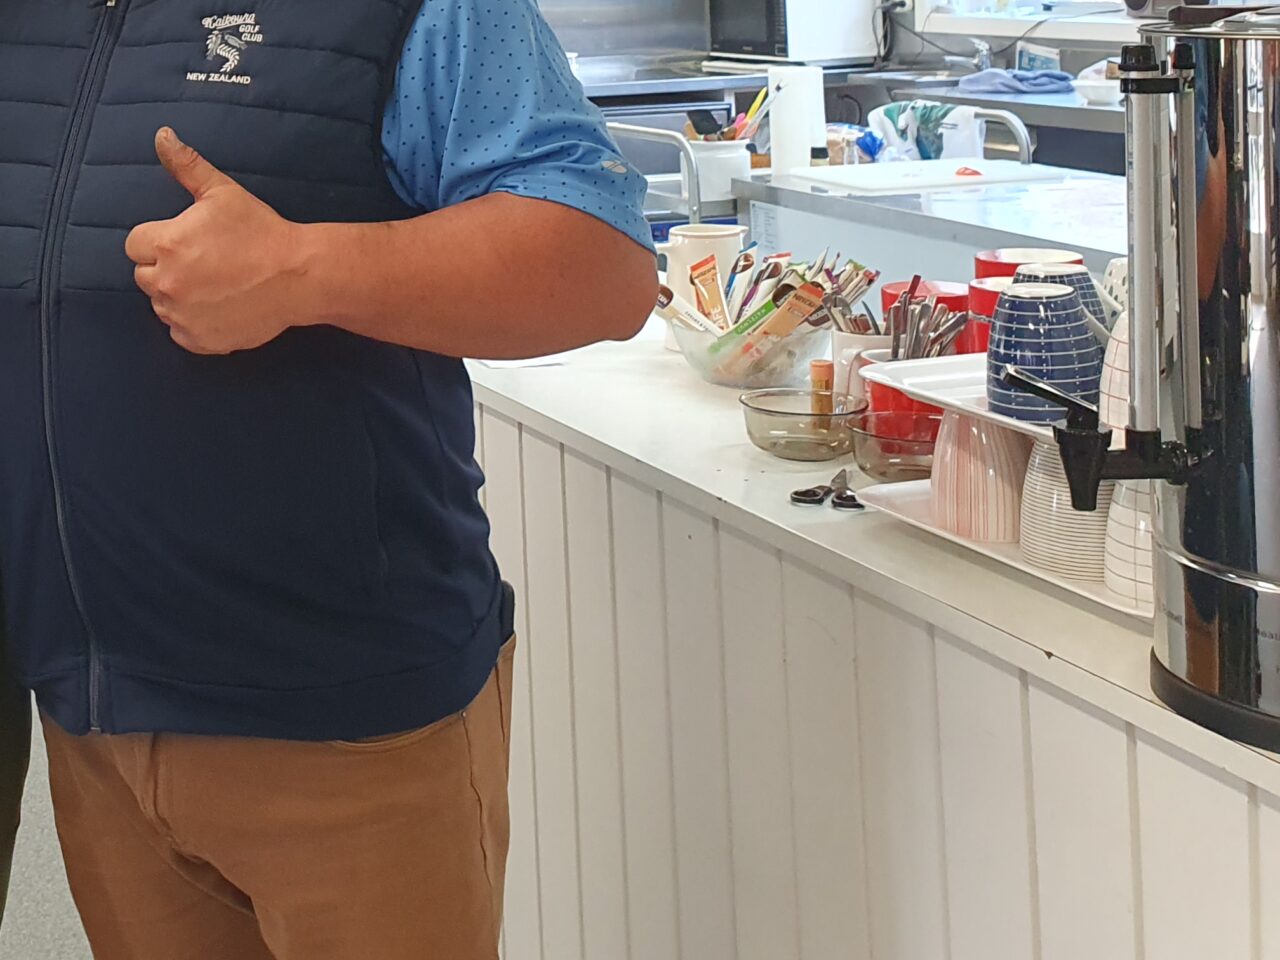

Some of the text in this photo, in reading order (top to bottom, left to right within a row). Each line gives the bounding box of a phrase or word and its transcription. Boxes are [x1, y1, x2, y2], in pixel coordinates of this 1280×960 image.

[201, 13, 256, 30] Kaikoura
[239, 25, 260, 33] GOLF
[241, 33, 263, 43] CLUB
[186, 72, 251, 84] NEW ZEALAND
